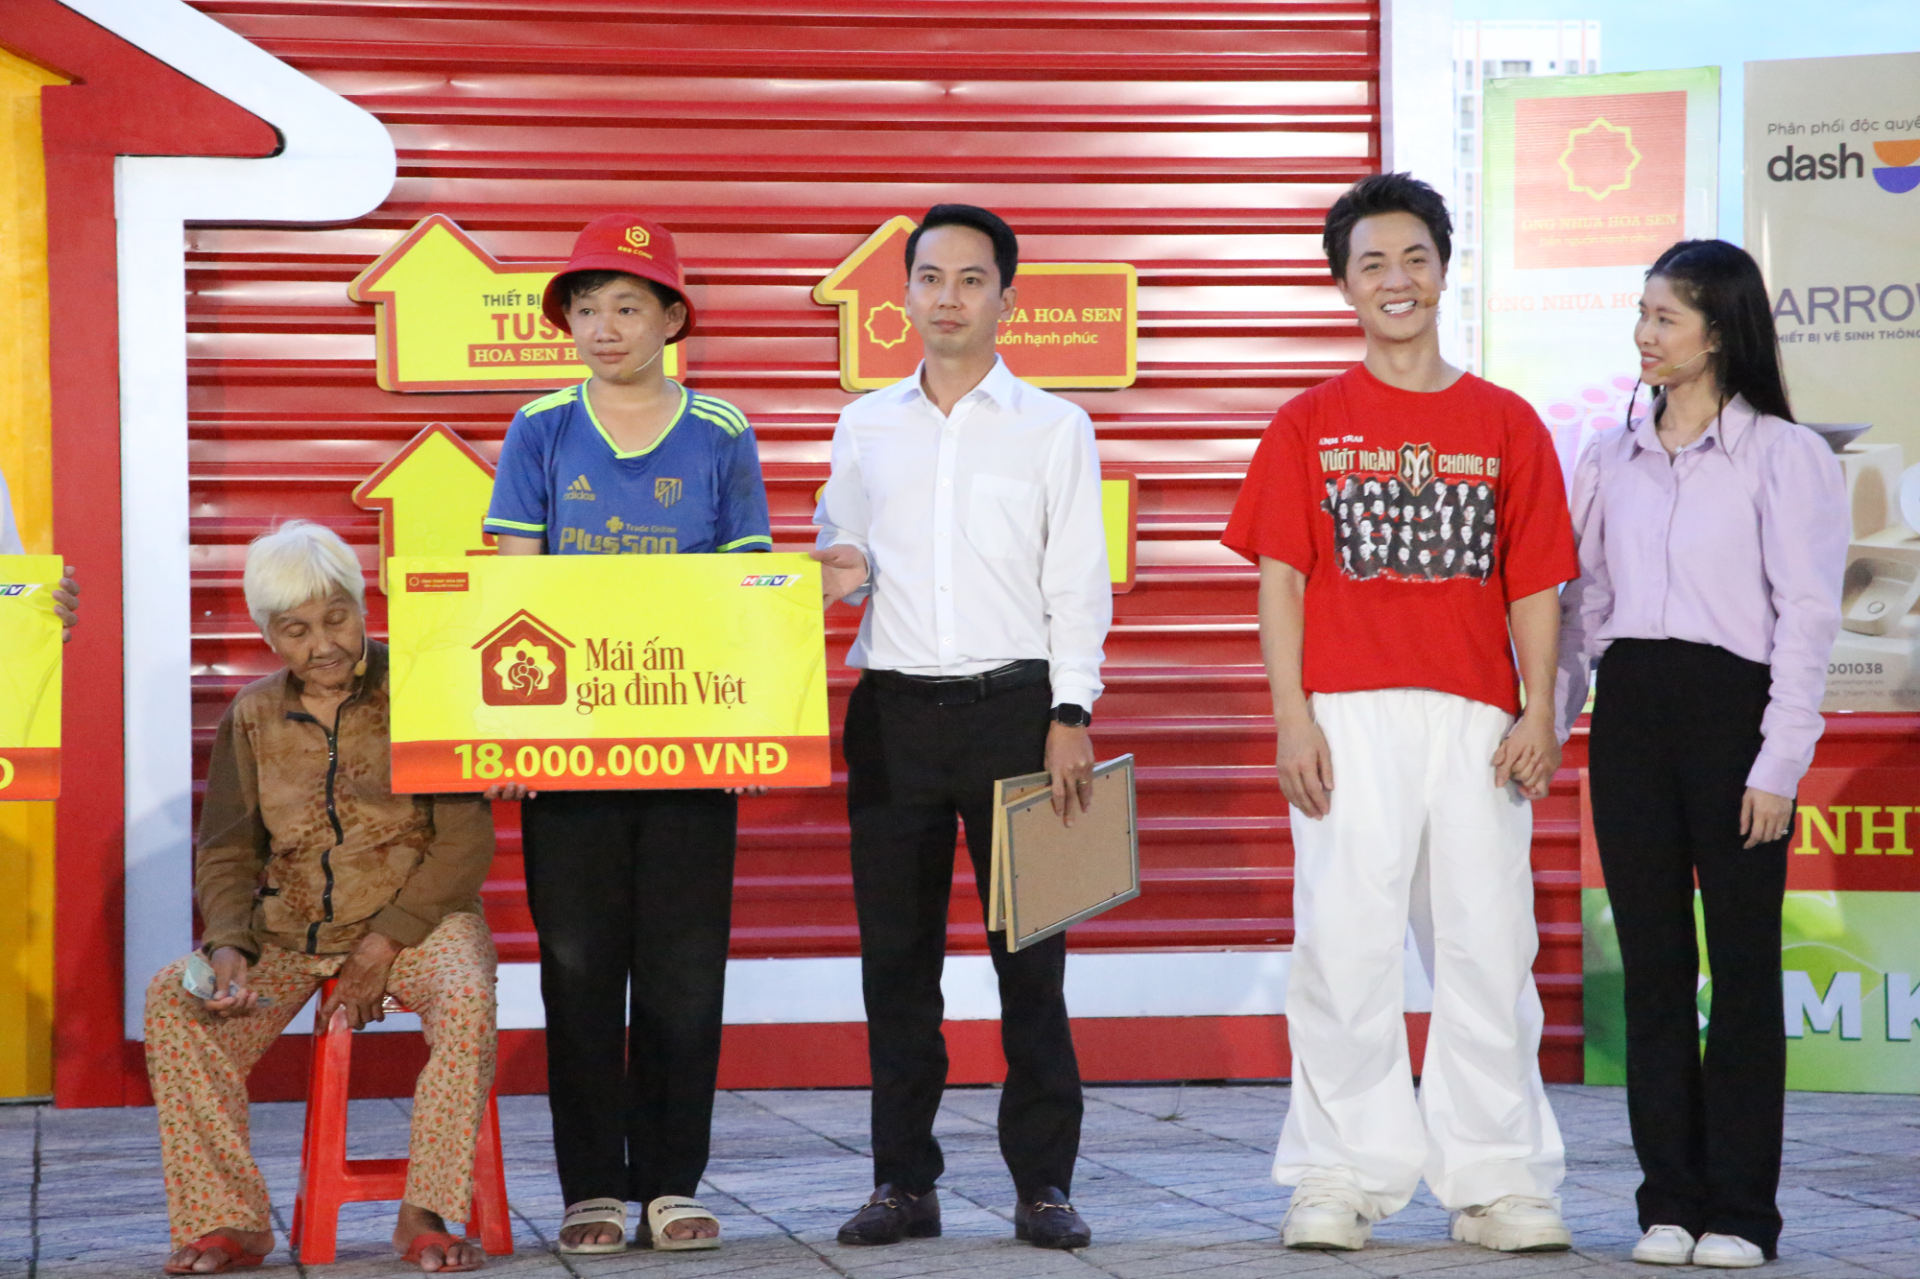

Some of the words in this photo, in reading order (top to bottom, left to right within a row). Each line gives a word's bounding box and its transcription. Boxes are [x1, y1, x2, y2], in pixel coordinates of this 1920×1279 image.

[1767, 122, 1806, 136] Phân
[1810, 118, 1845, 136] phối
[1849, 118, 1880, 134] độc
[1767, 142, 1864, 182] dash
[482, 289, 522, 307] THIẾT
[527, 293, 541, 309] BỊ
[1611, 291, 1643, 308] HO
[1772, 282, 1920, 326] ARRO
[1033, 308, 1077, 323] HOA
[1081, 307, 1123, 322] SEN
[1024, 332, 1060, 347] hạnh
[1063, 331, 1099, 346] phúc
[1775, 330, 1804, 344] HIẾT
[1808, 332, 1820, 344] BỊ
[1824, 330, 1841, 344] VỆ
[1845, 330, 1875, 342] SINH
[473, 348, 516, 363] HOA
[520, 347, 559, 362] SEN
[1359, 446, 1396, 472] NGÀN
[563, 491, 596, 501] adidas
[558, 527, 678, 555] Plus500
[740, 574, 803, 587] HTV7
[585, 638, 634, 672] Mái
[642, 636, 686, 671] ấm
[1827, 662, 1884, 675] 001038
[576, 677, 616, 715] gia
[624, 671, 688, 706] đình
[693, 671, 748, 709] Việt
[454, 742, 685, 779] 18.000.000
[693, 742, 789, 775] VNĐ
[1794, 805, 1920, 855] NH
